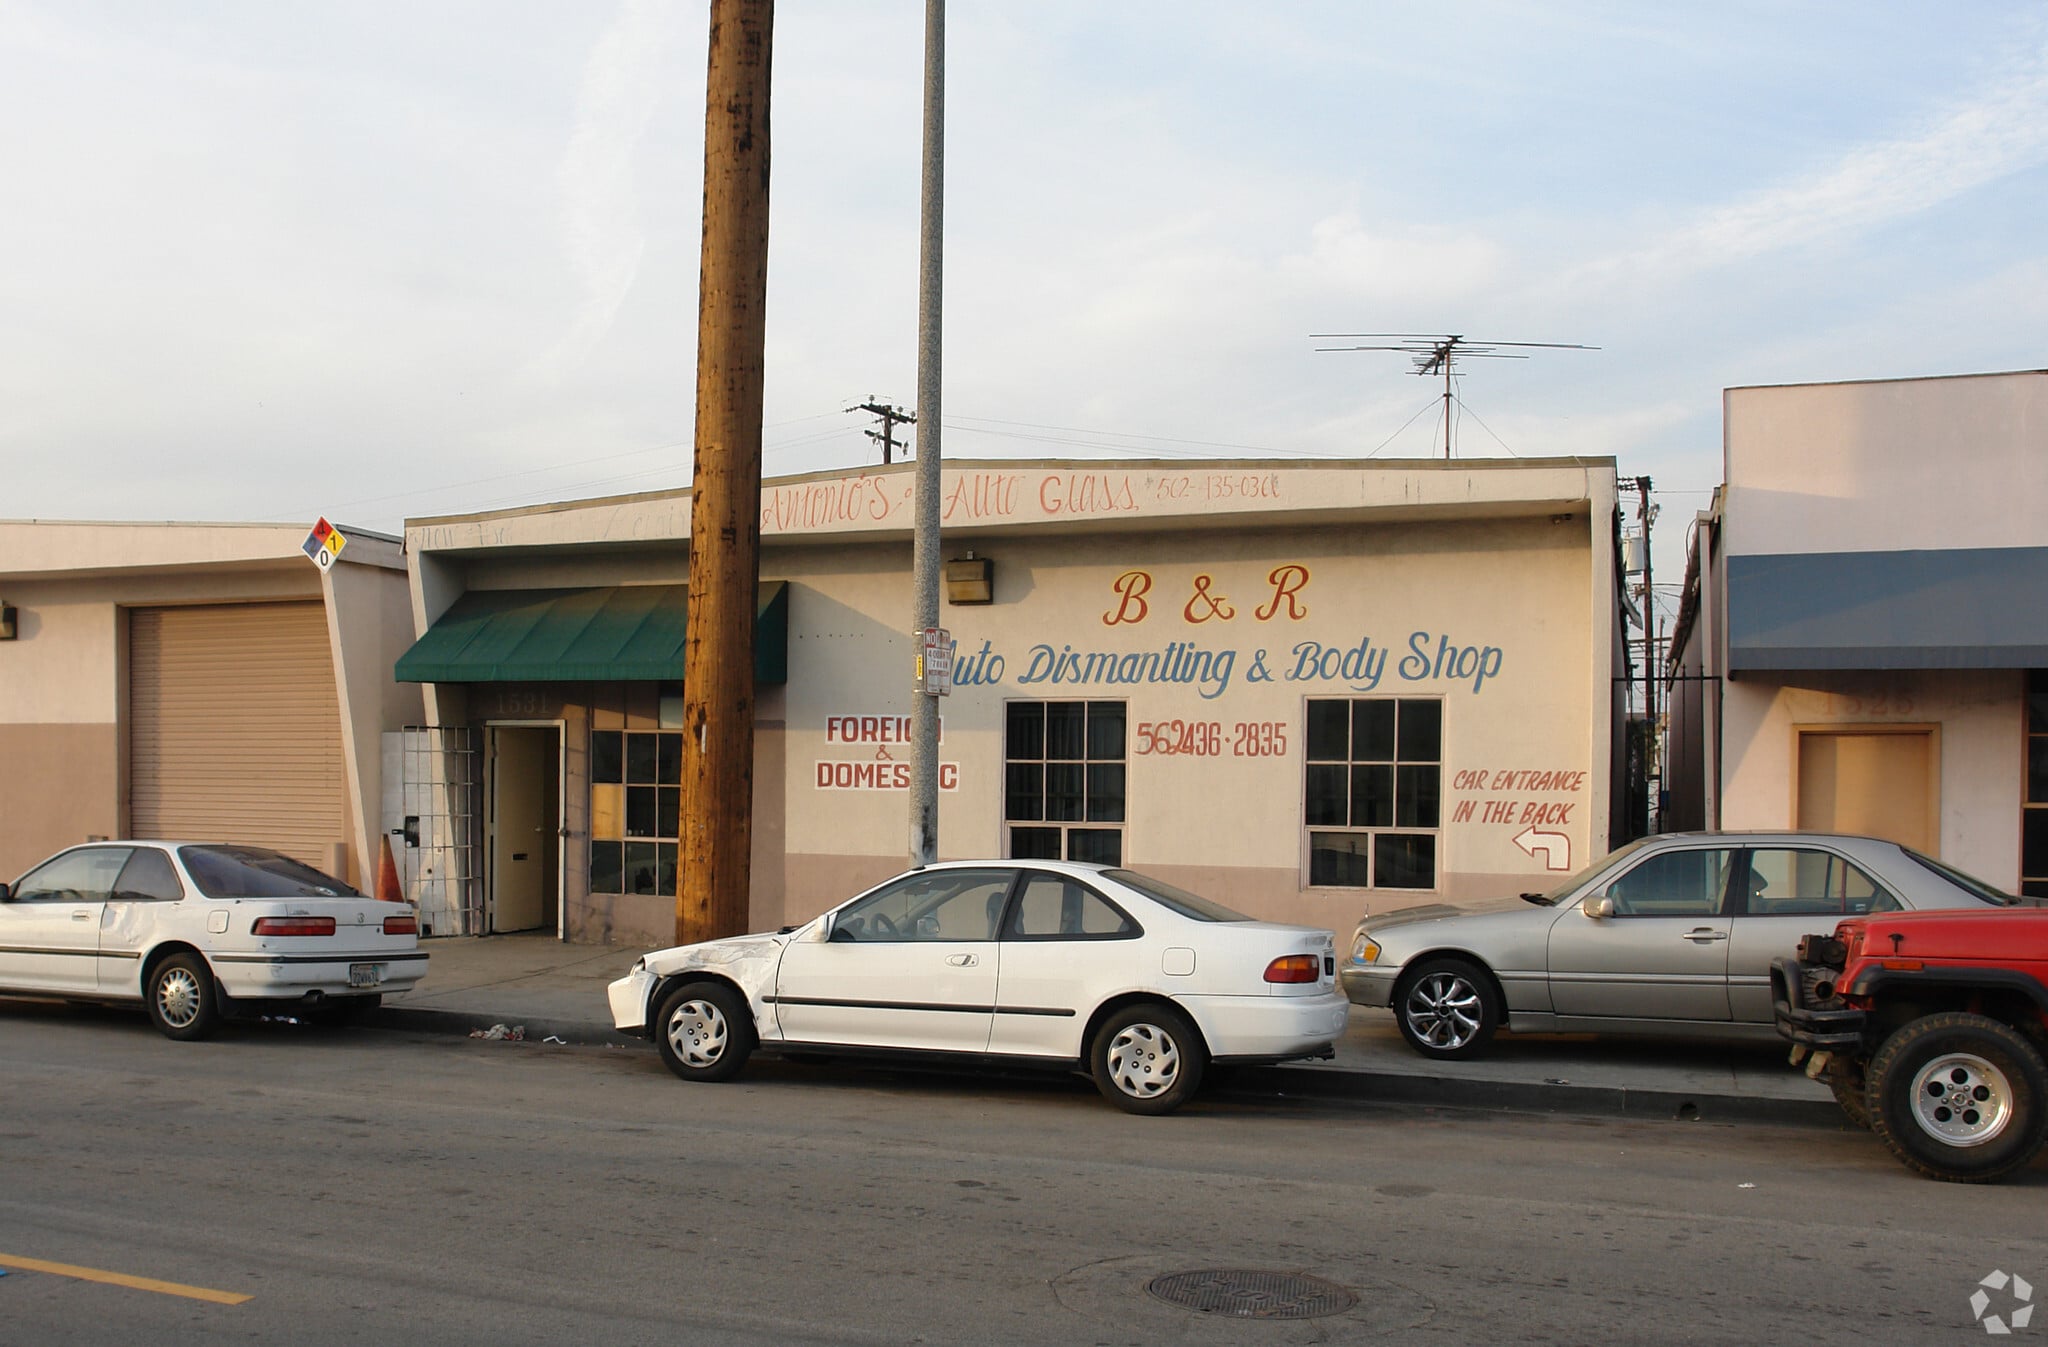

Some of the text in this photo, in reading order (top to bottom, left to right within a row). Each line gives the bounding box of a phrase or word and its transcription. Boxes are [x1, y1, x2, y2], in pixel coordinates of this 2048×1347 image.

[329, 534, 337, 551] 1
[320, 550, 329, 567] 0
[1101, 564, 1311, 627] B & R
[1017, 643, 1237, 700] Dismantling
[1246, 648, 1275, 683] &
[1284, 632, 1389, 692] Body
[1398, 631, 1504, 695] Shop
[827, 716, 942, 743] FOREI
[875, 743, 894, 761] &
[817, 763, 957, 790] DOMESC
[1453, 769, 1587, 791] CAR ENTRANCE
[1451, 800, 1576, 825] IN THE BACK
